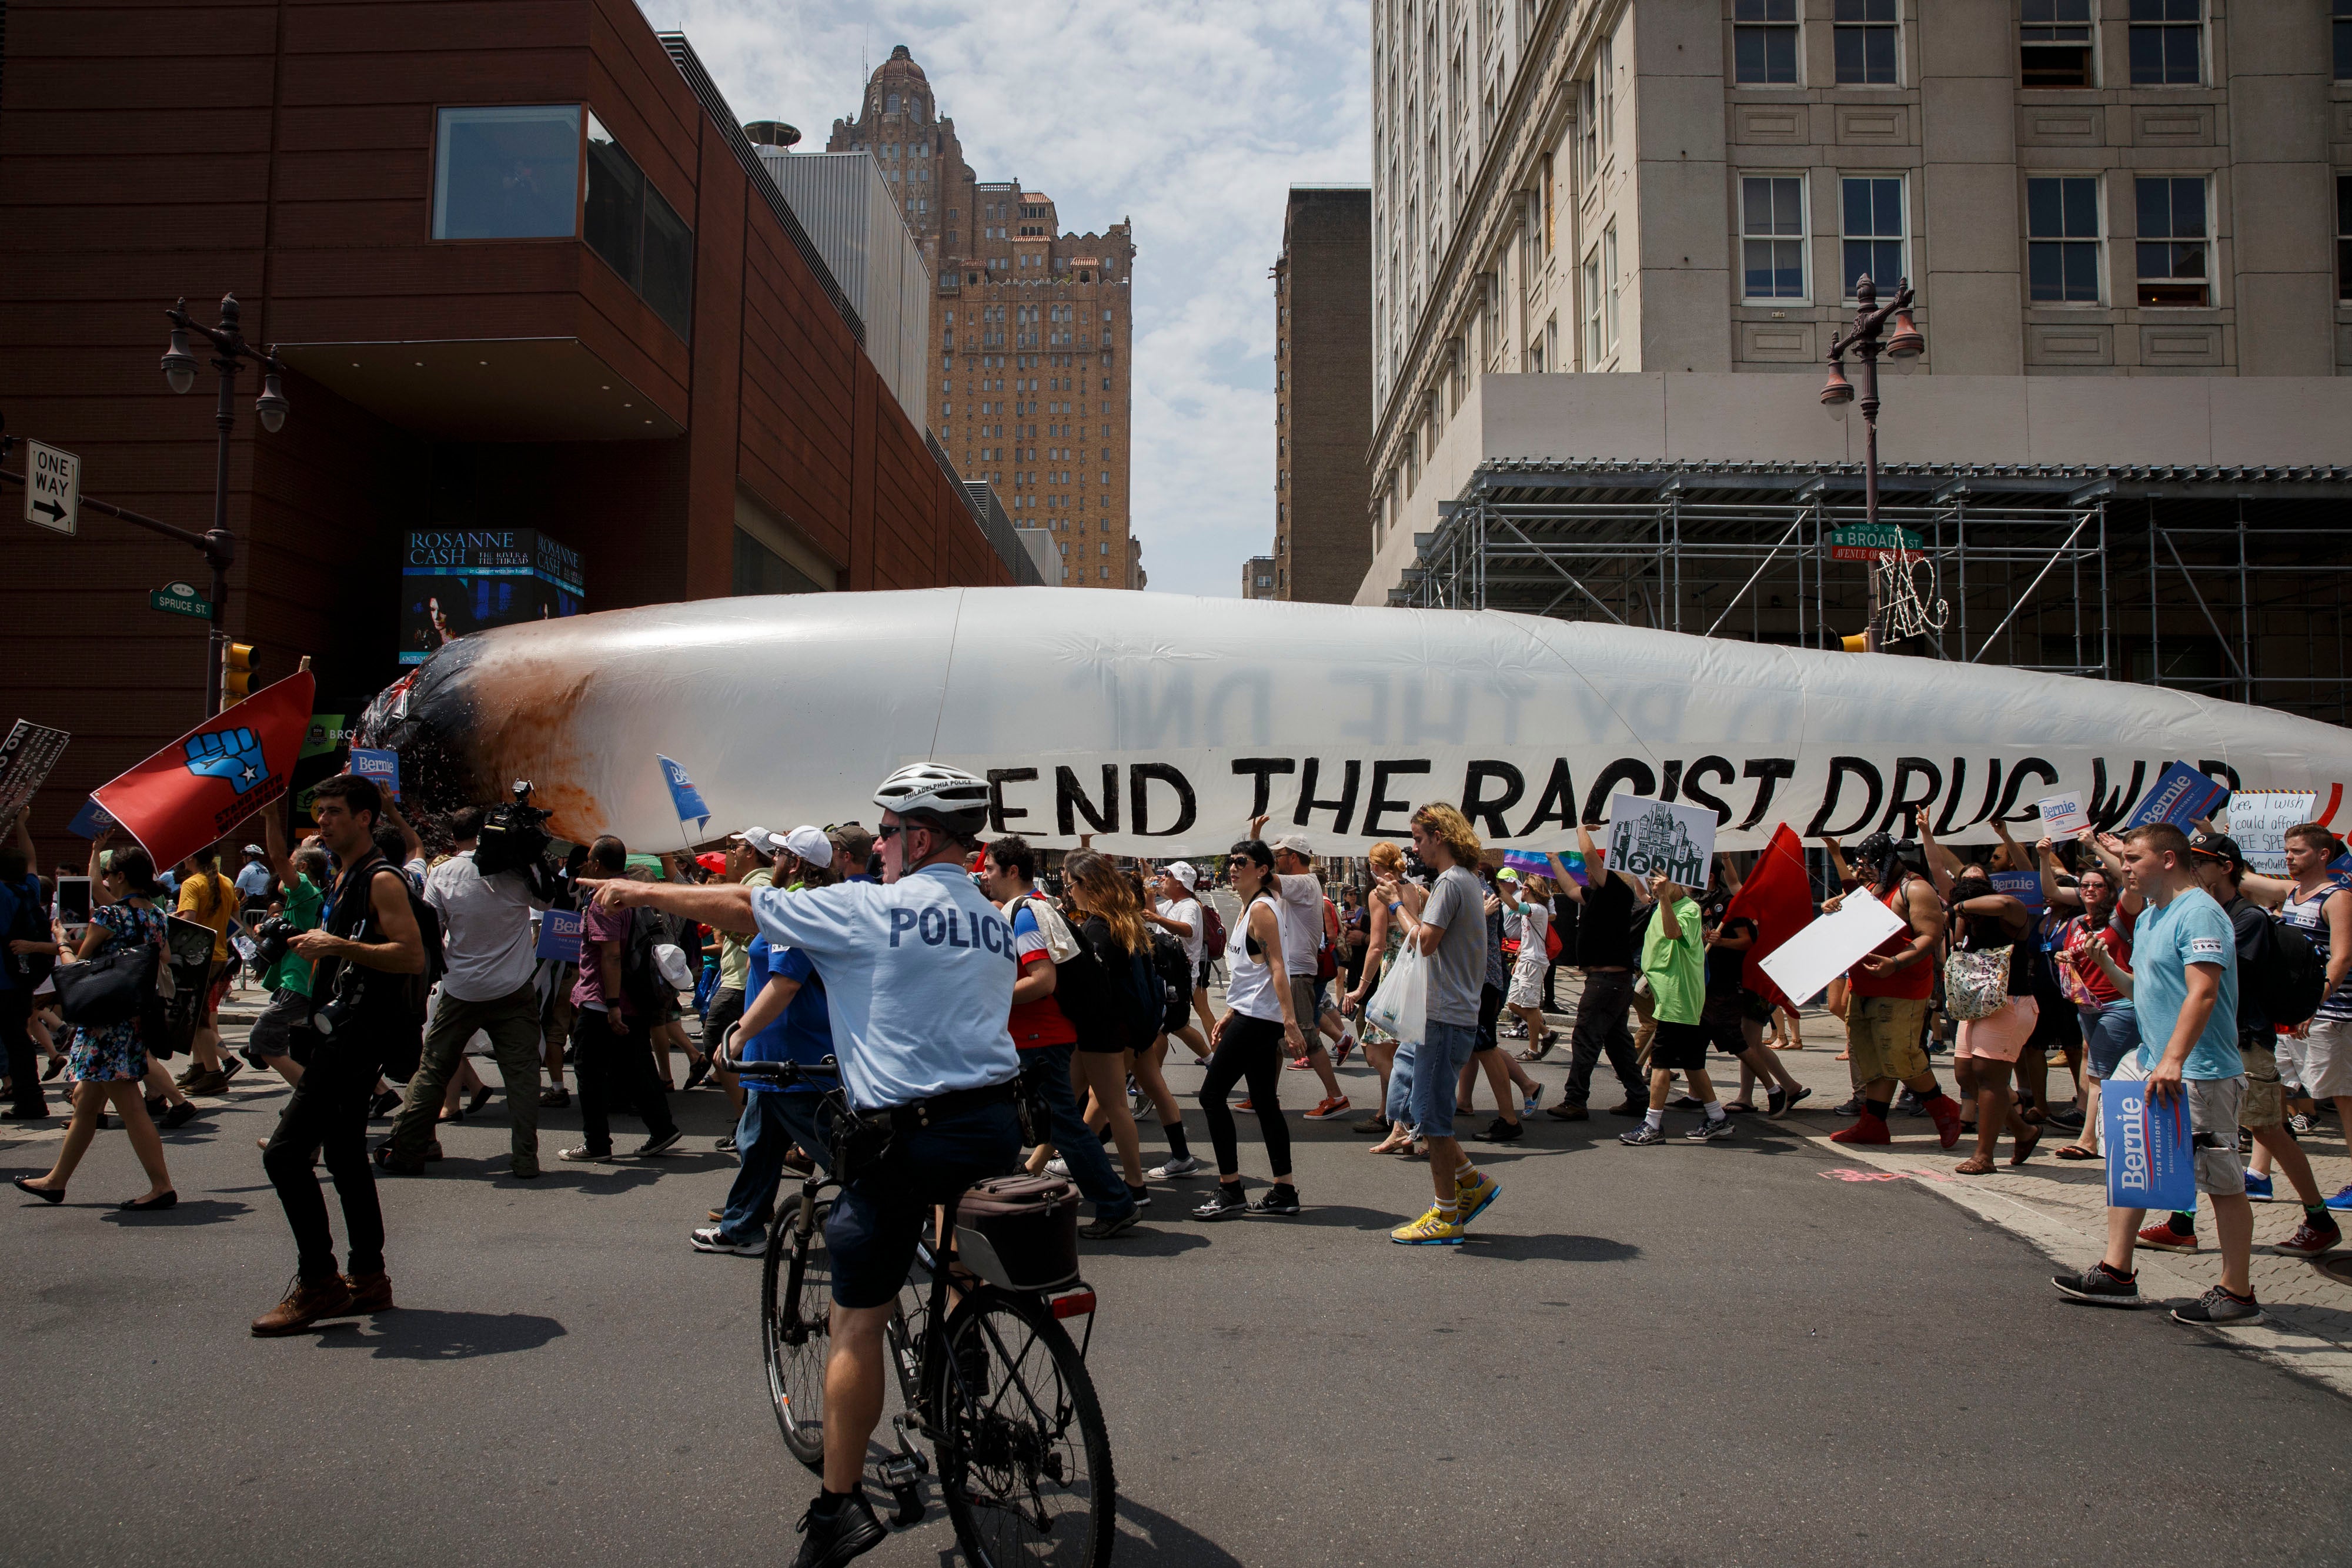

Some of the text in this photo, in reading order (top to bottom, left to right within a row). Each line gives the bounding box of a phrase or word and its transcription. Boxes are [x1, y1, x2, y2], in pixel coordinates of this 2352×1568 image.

[38, 452, 68, 477] ONE
[36, 472, 69, 497] WAY
[1874, 524, 1879, 532] S
[411, 533, 513, 549] ROSANNE
[1848, 531, 1919, 549] BROAD ST
[410, 549, 466, 565] CASH
[537, 534, 579, 569] ROSANNE
[1835, 548, 1866, 559] AVENUE
[1869, 550, 1880, 560] OF
[537, 551, 560, 576] CASH
[159, 596, 207, 614] SPRUCE ST.
[6, 725, 29, 751] NO
[29, 728, 42, 744] the
[35, 730, 51, 749] Roe
[16, 747, 29, 765] ash
[34, 743, 51, 763] long
[44, 734, 68, 768] Trump
[25, 766, 36, 780] for
[358, 757, 394, 774] Bernie
[11, 762, 31, 789] Wade
[14, 782, 26, 798] the
[215, 773, 283, 824] STAND WITH
[903, 781, 948, 801] PHILADELPHIA
[987, 762, 1197, 837] END
[1231, 757, 1431, 837] THE
[1459, 755, 1796, 839] RACIST
[1804, 756, 2059, 839] DRUG
[2092, 756, 2241, 833] WR
[2140, 775, 2191, 824] Bernie
[218, 782, 284, 834] WISCONSIN
[2043, 800, 2076, 818] Bernie
[2175, 793, 2195, 816] PRESIDENT
[2264, 793, 2269, 809] I
[2274, 795, 2304, 809] wish
[2235, 814, 2264, 830] could
[2229, 833, 2285, 851] FREE SPE
[1992, 877, 2034, 892] Bernie
[890, 907, 1015, 964] POLICE
[2121, 1097, 2145, 1191] Bernie
[2154, 1114, 2162, 1158] PRESIDENT
